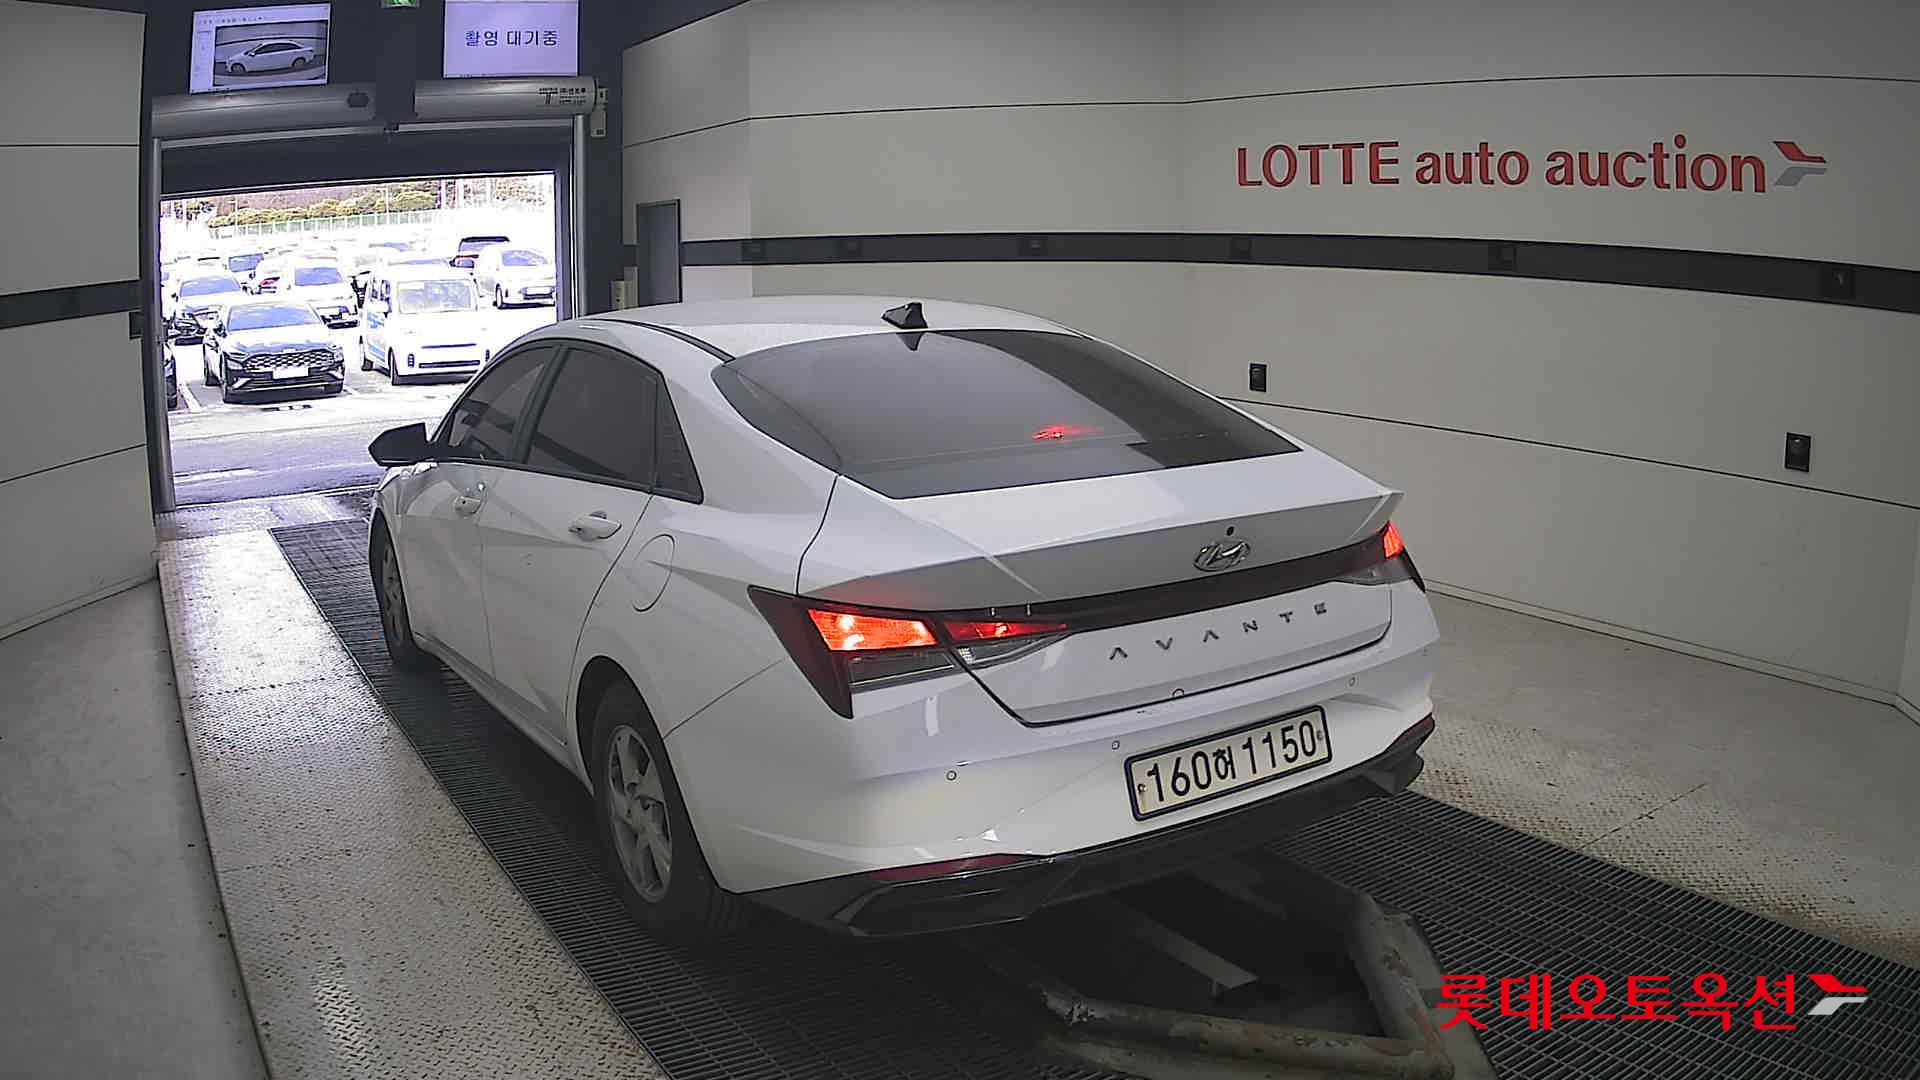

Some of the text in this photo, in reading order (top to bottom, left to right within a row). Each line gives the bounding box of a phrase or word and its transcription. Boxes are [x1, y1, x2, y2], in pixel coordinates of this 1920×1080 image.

[465, 30, 558, 46] 촬영 대기중
[1237, 134, 1767, 193] LOTTE auto auction
[1109, 602, 1327, 660] AVANTE
